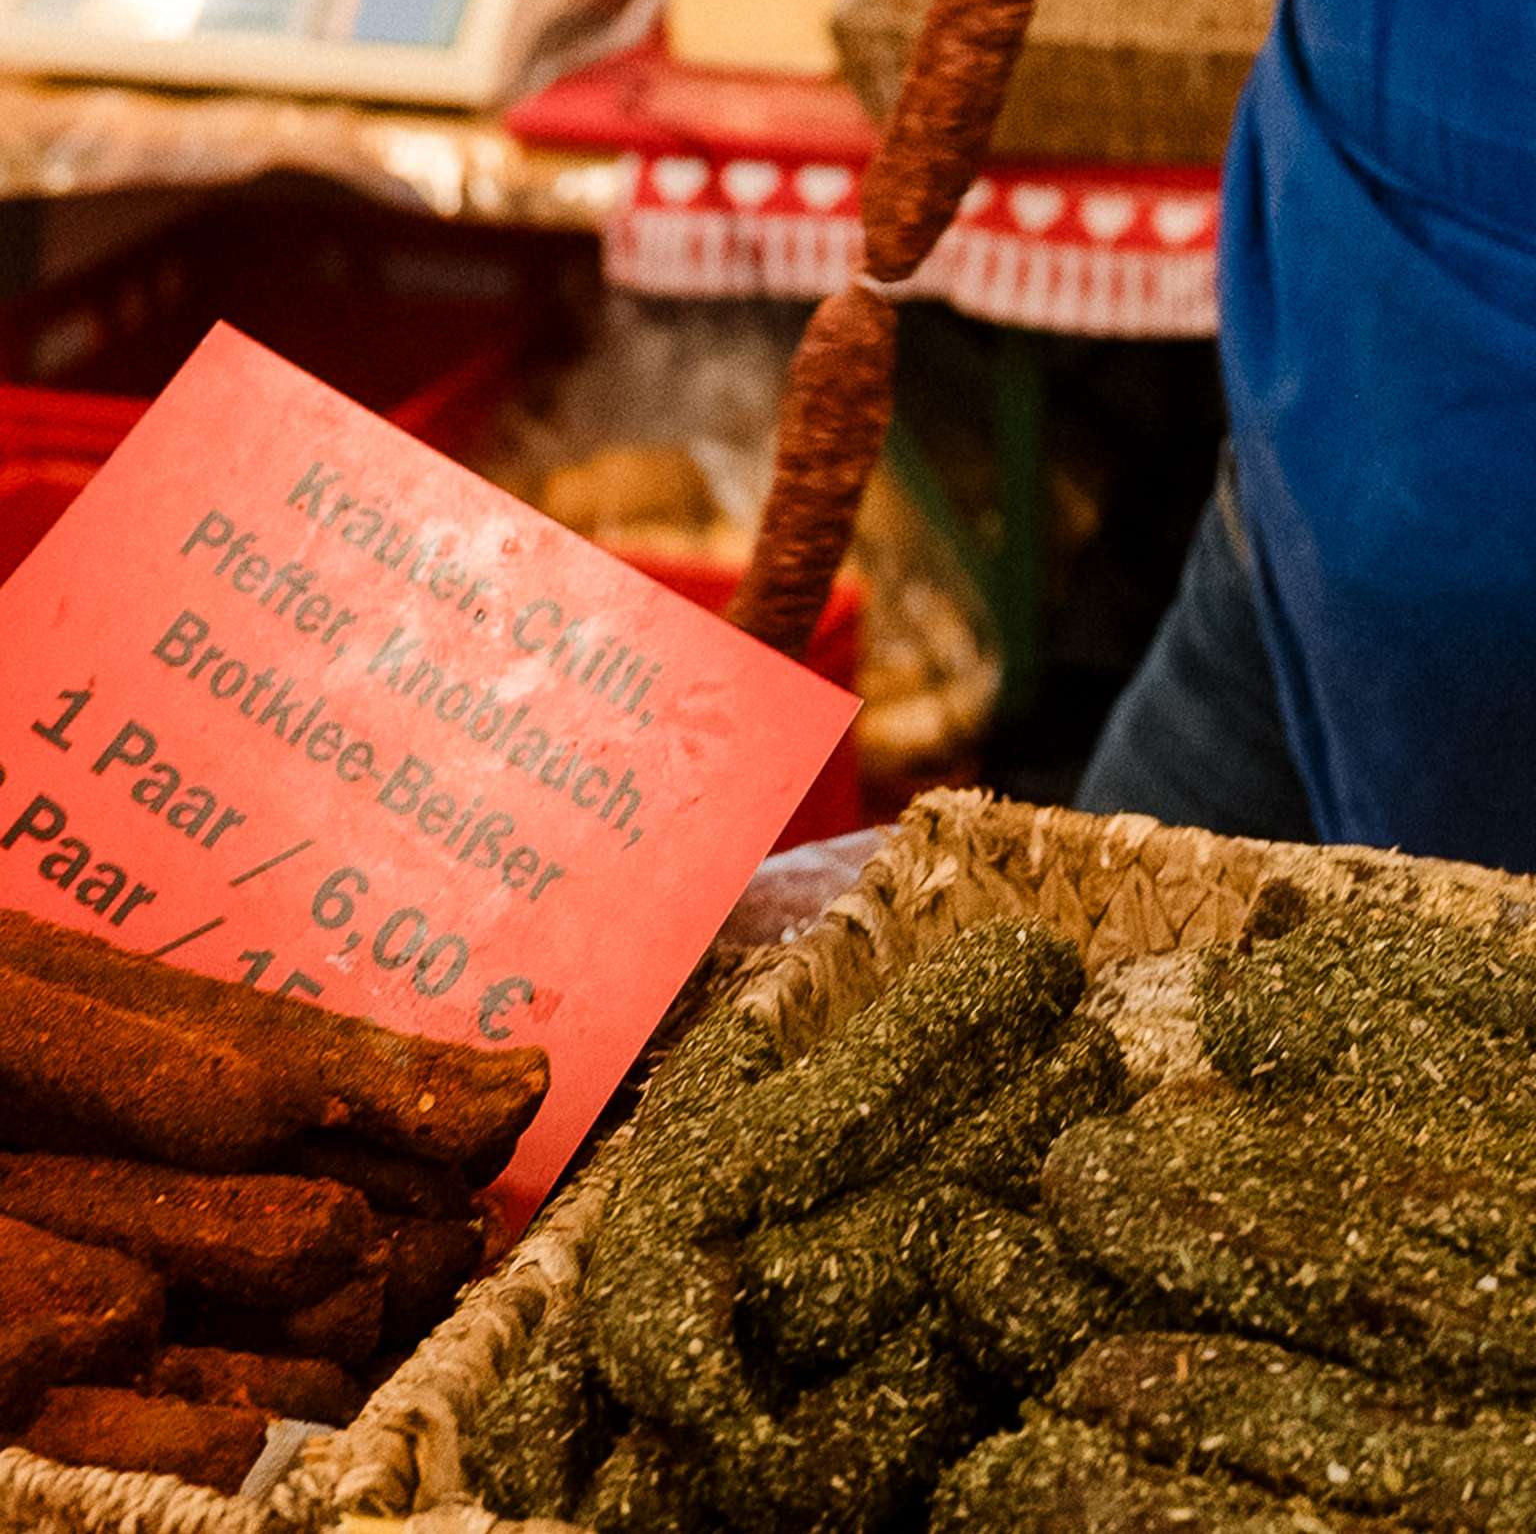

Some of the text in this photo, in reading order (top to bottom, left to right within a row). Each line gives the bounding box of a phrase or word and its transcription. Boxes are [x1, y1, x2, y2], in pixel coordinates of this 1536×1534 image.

[151, 609, 566, 902] Brotklee-Beißer
[180, 509, 645, 852] Pfeffer, Knoblauch,
[512, 599, 663, 731] Chilli,
[1, 792, 158, 927] Paar
[31, 688, 93, 752] 1
[91, 719, 247, 850] Paar
[311, 866, 468, 998] 6,00
[477, 975, 535, 1041] €
